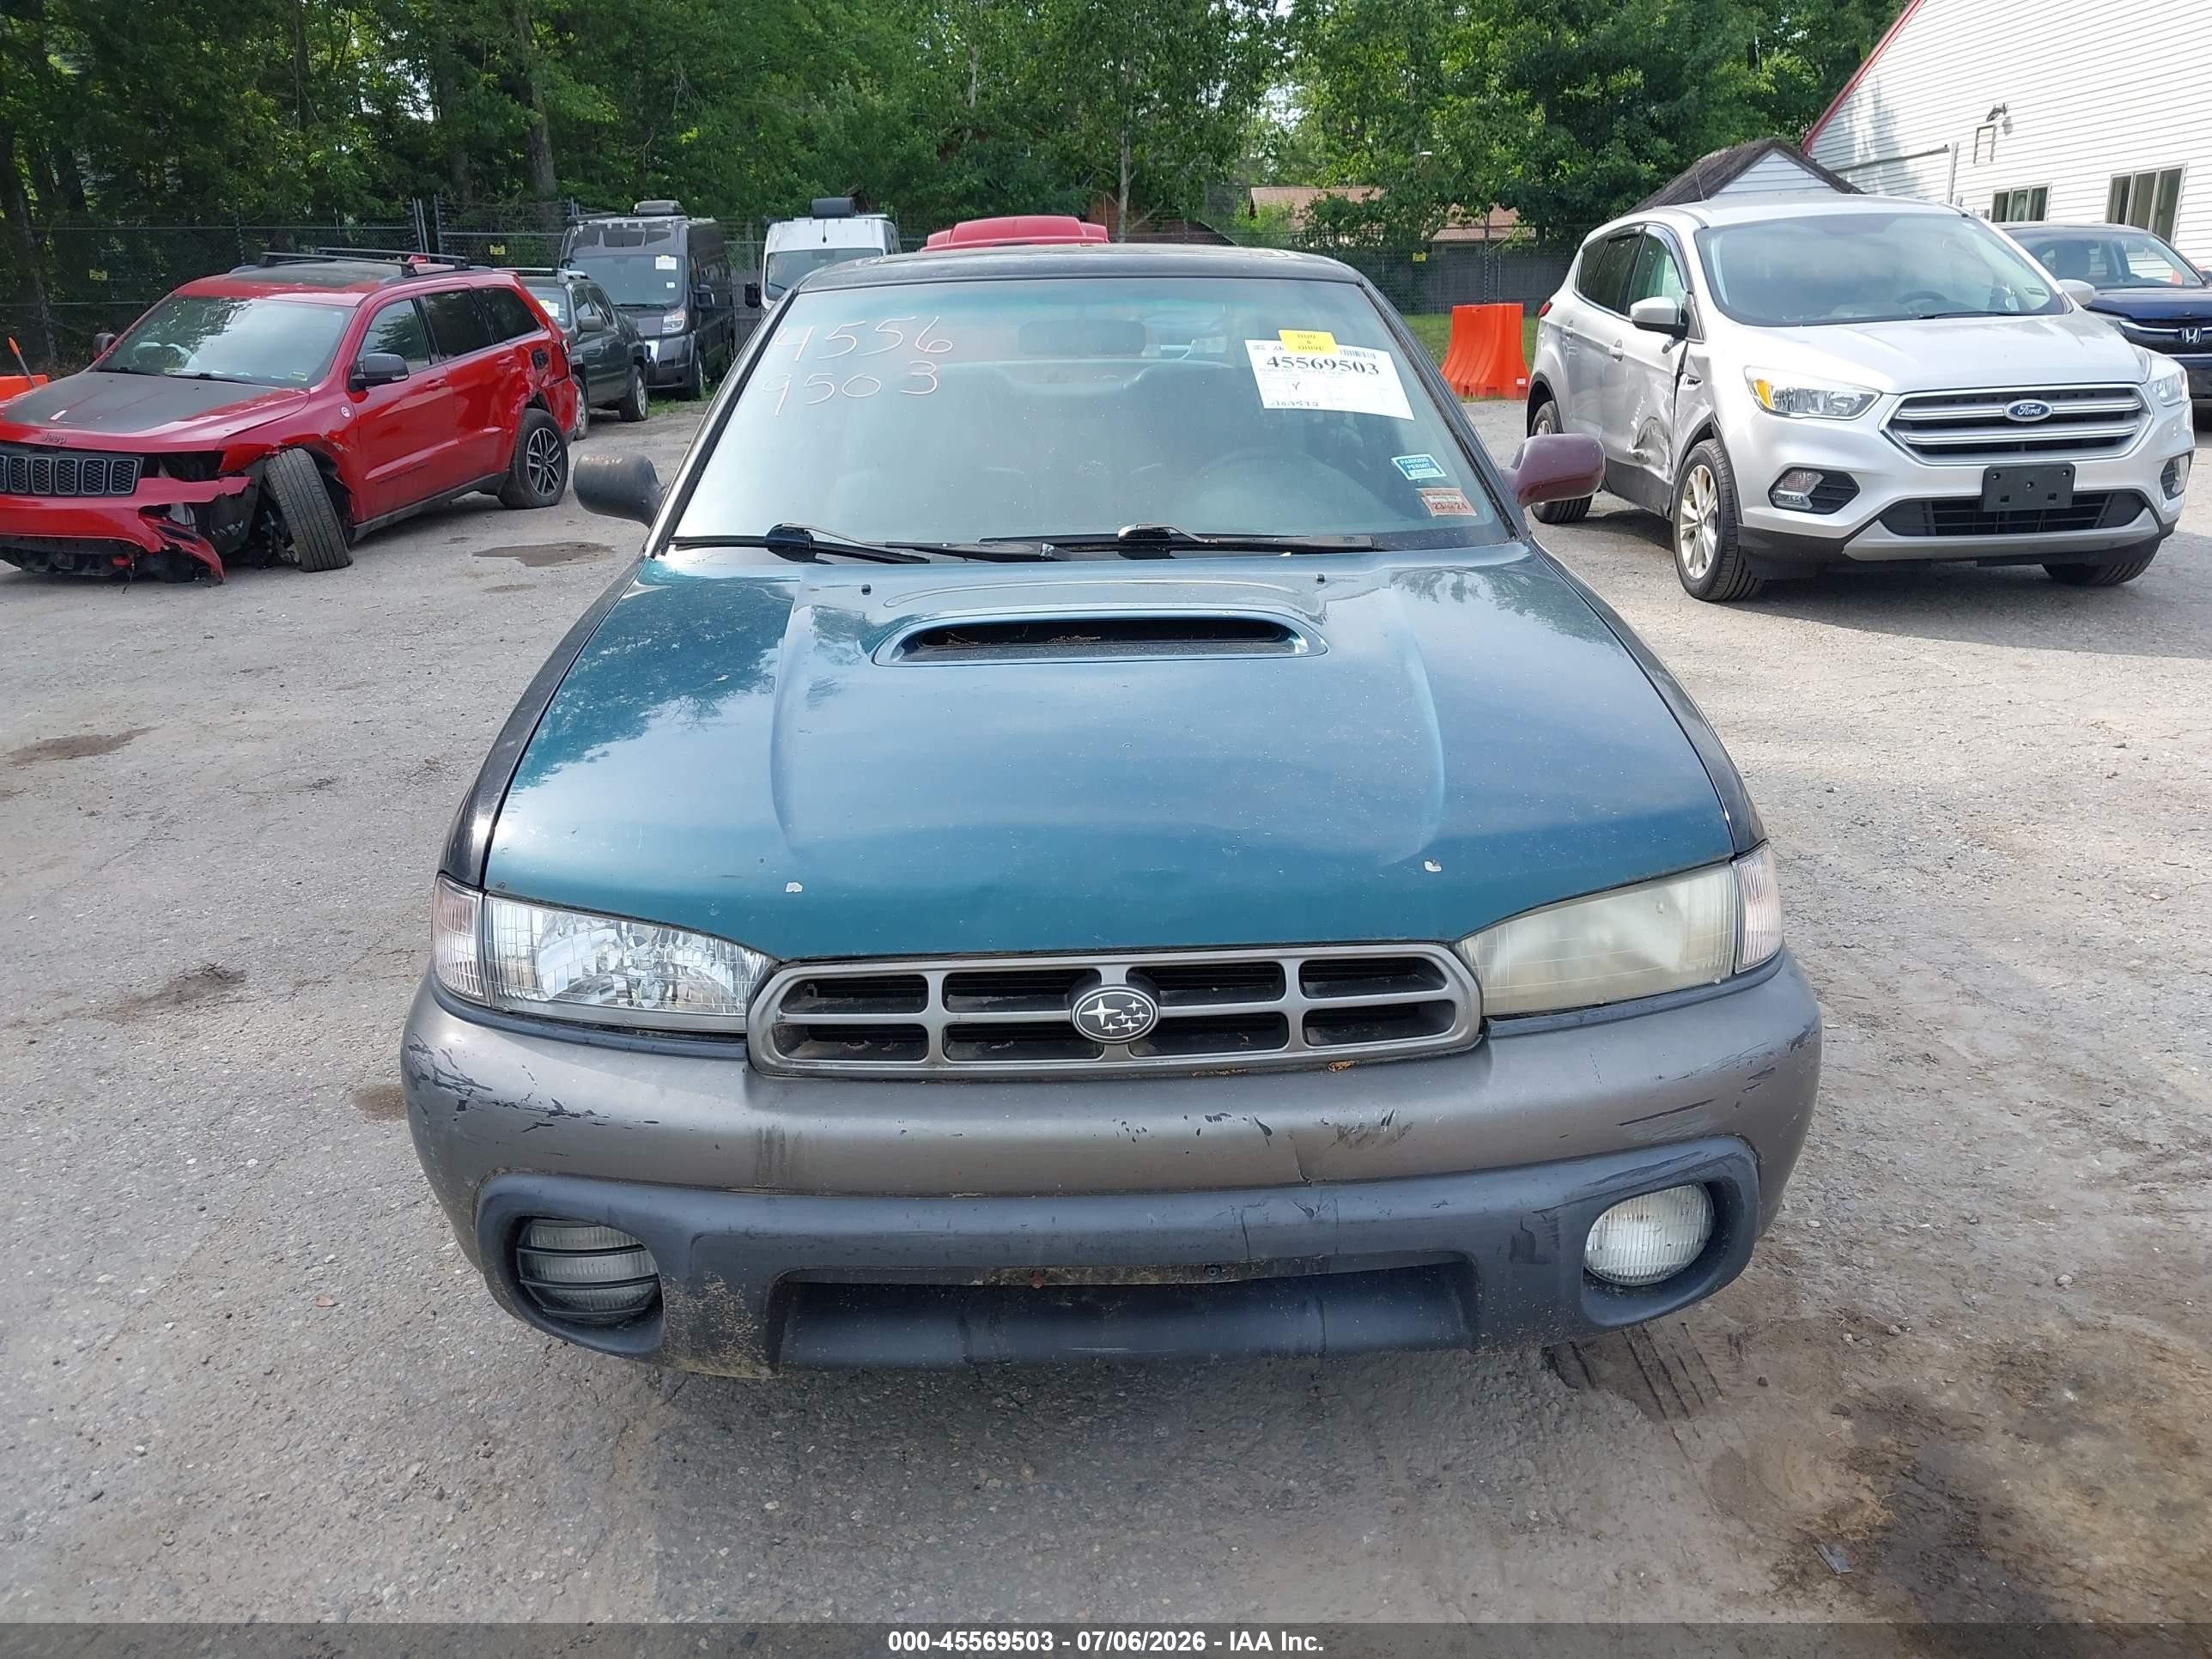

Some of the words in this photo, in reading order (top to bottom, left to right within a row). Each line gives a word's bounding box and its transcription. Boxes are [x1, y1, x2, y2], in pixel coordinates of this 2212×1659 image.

[775, 315, 953, 362] 4556
[1267, 356, 1380, 376] 45569503
[763, 360, 939, 417] 9503
[2017, 404, 2042, 416] Ford
[41, 432, 68, 446] Jeep
[1400, 457, 1430, 465] PARKING
